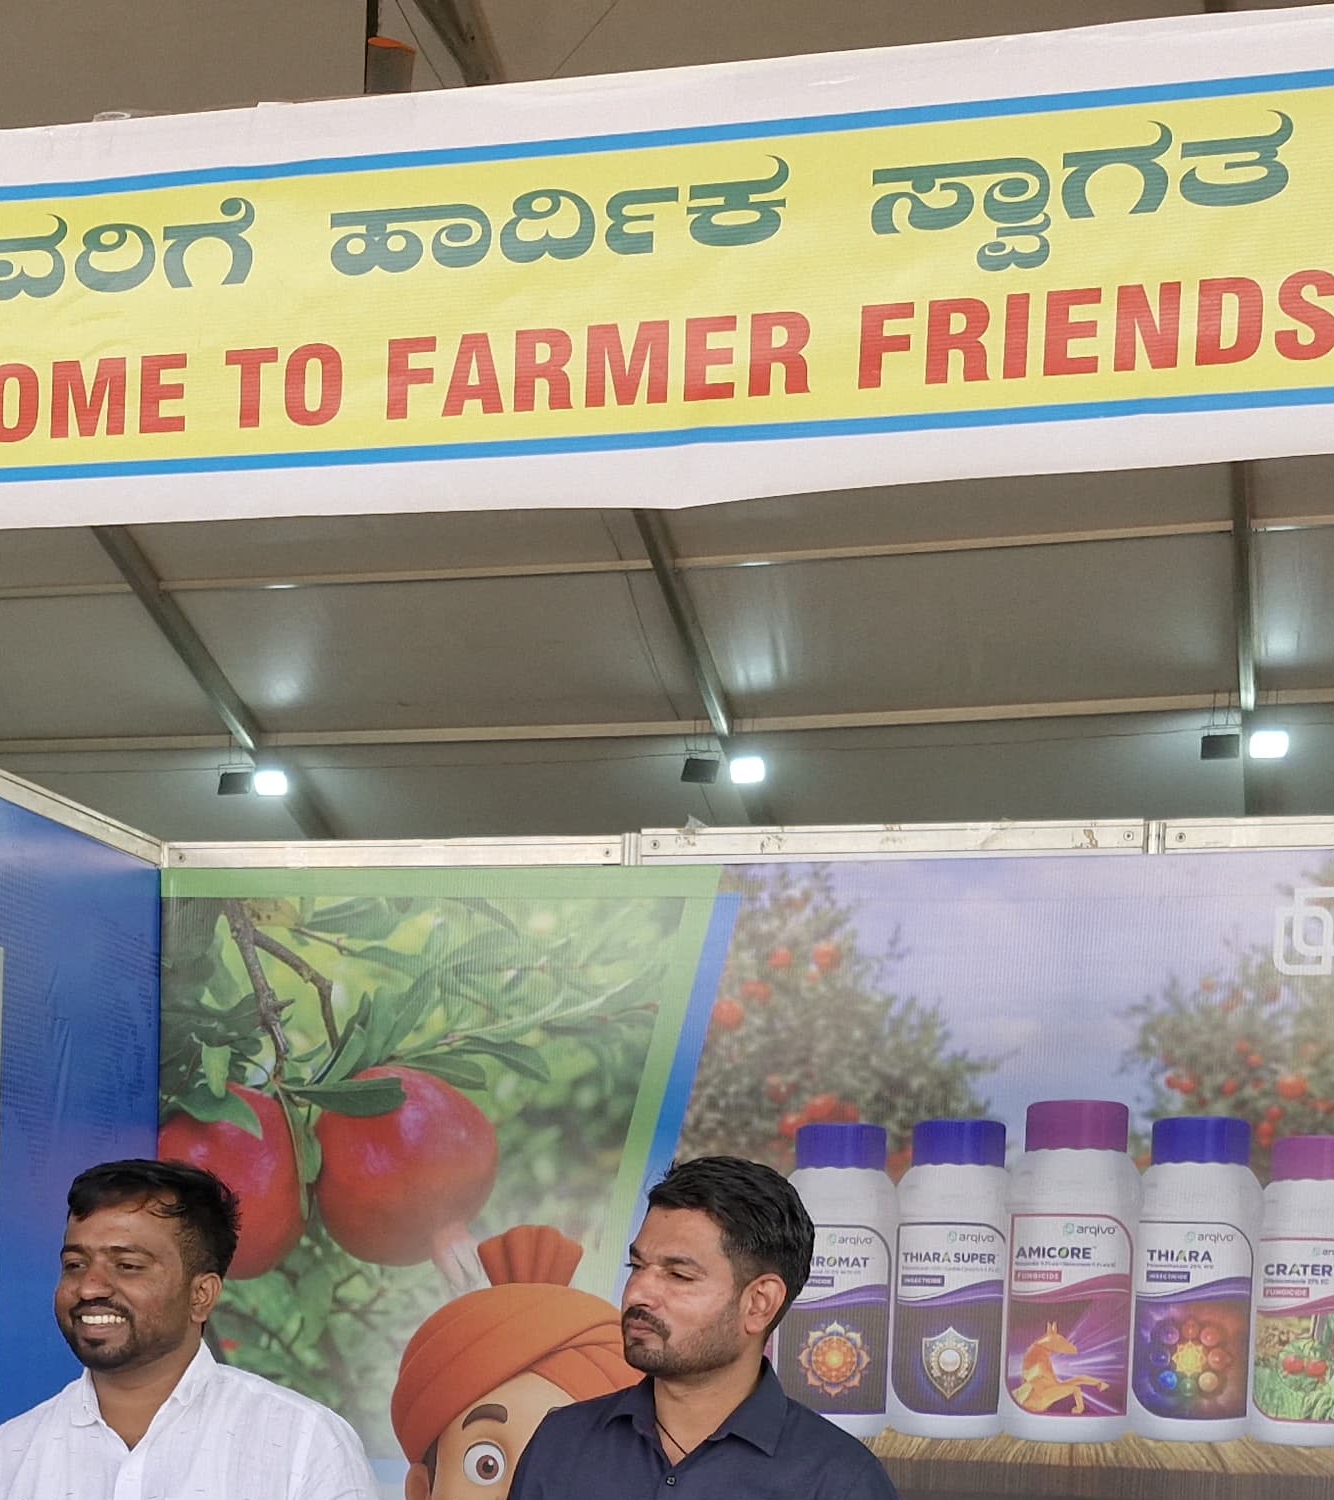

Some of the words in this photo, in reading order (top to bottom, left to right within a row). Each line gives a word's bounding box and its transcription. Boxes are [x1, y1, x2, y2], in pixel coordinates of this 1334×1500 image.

[330, 155, 790, 275] ಹಾರ್ದಿಕ
[871, 110, 1294, 271] ಸ್ವಾಗತ
[225, 343, 342, 430] TO
[386, 311, 812, 420] FARMER
[902, 1252, 951, 1263] THIARA
[953, 1253, 996, 1264] SUPER
[1015, 1247, 1092, 1260] AMICORE
[1147, 1249, 1212, 1262] THIARA
[1264, 1263, 1333, 1277] CRATER
